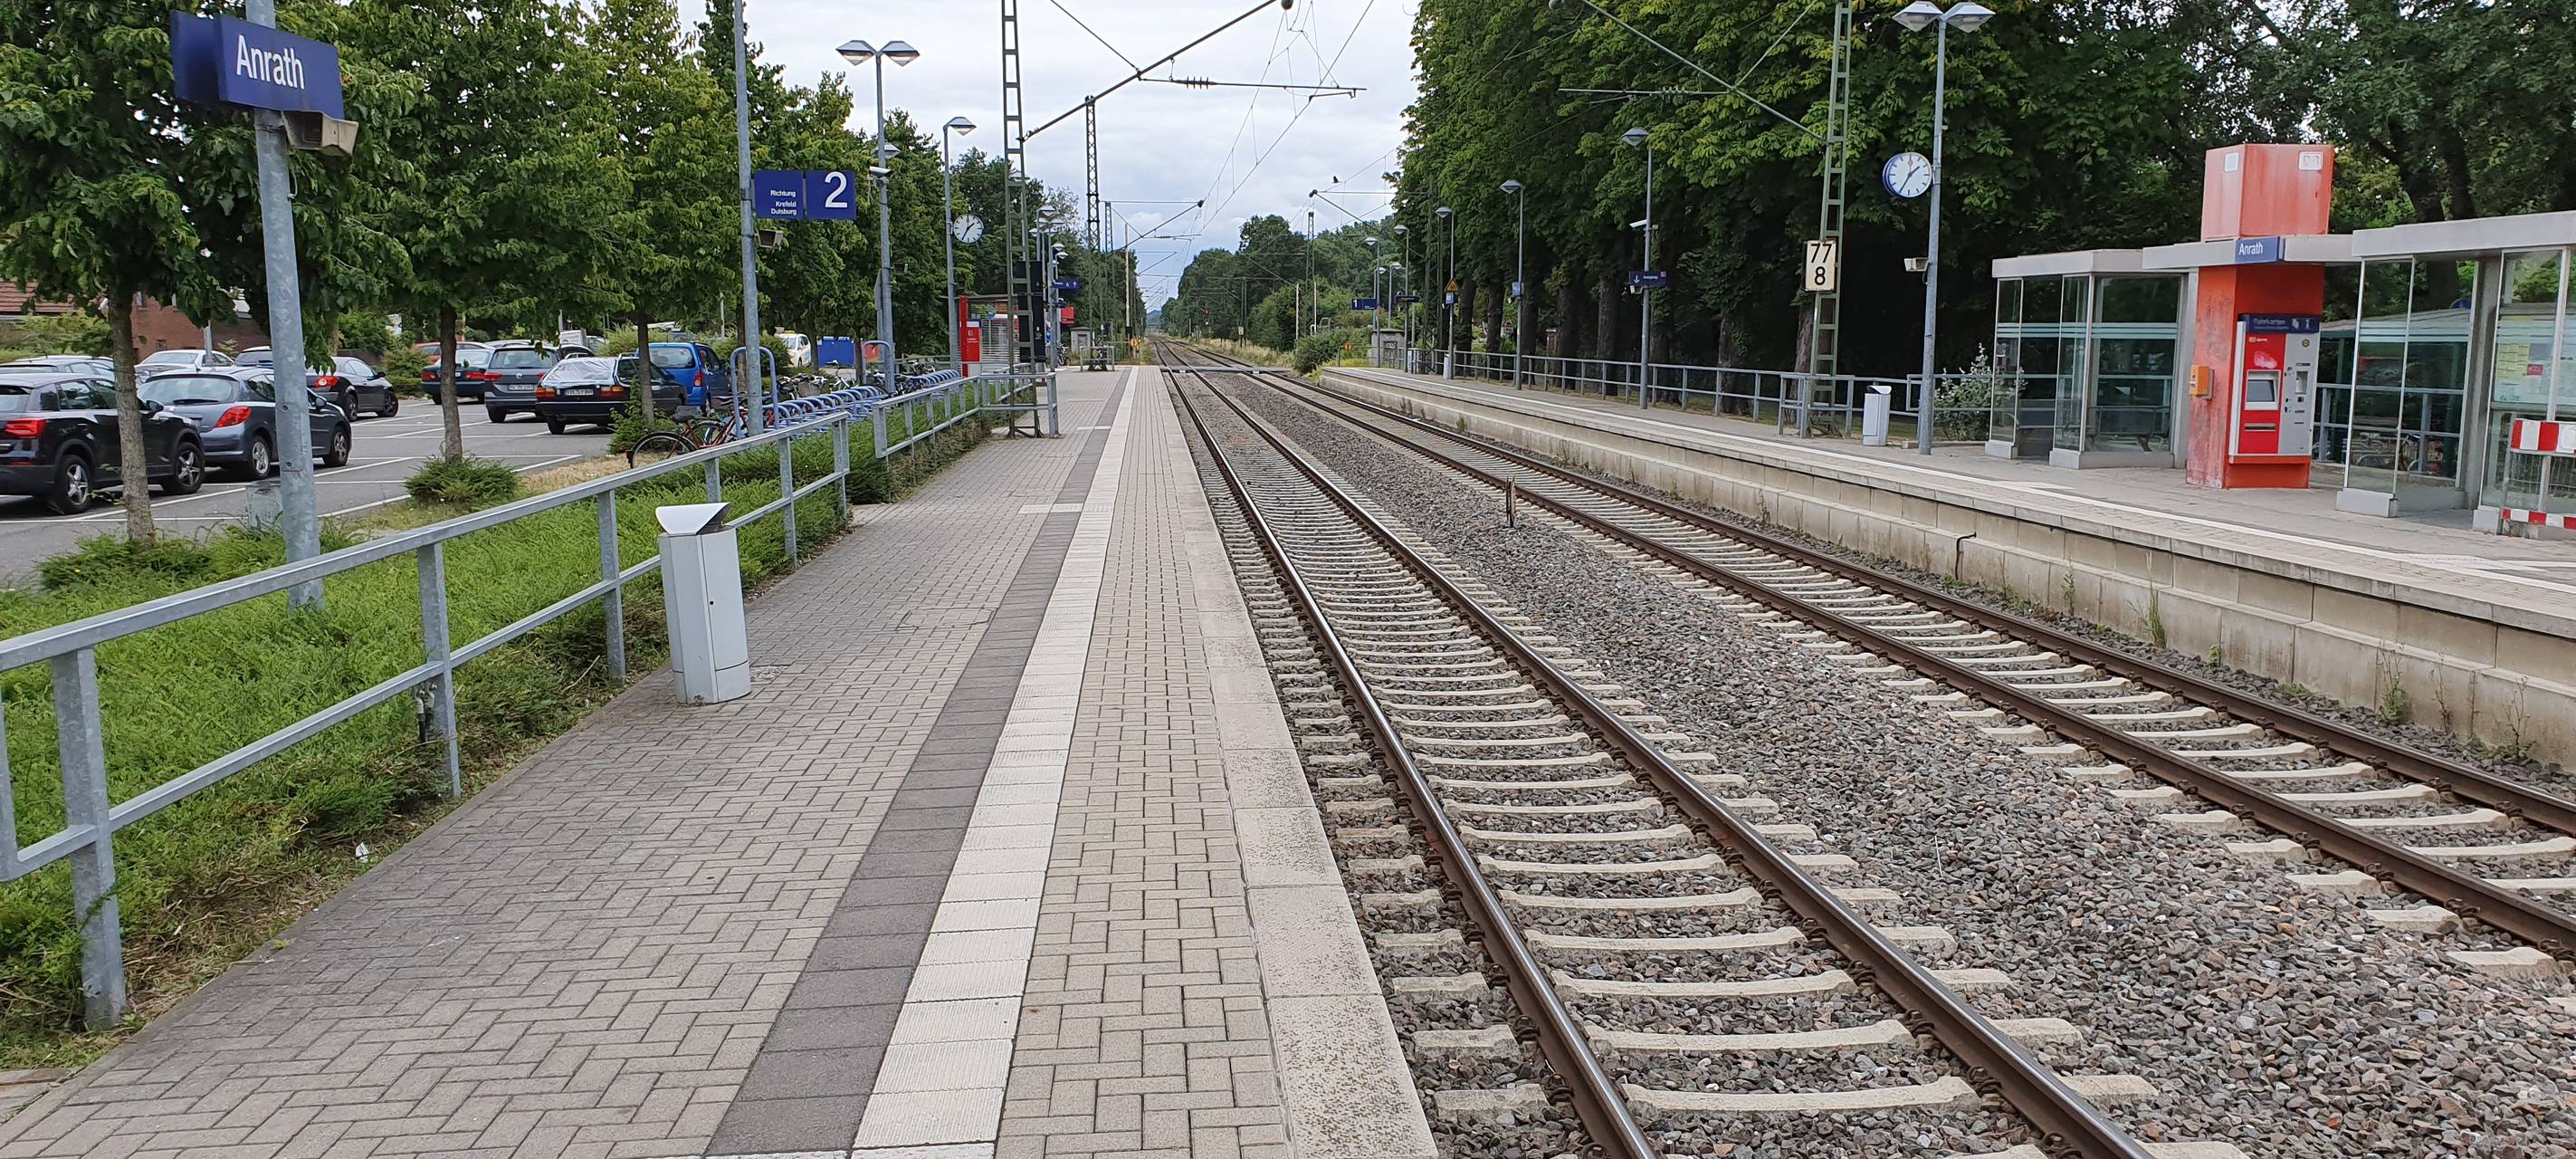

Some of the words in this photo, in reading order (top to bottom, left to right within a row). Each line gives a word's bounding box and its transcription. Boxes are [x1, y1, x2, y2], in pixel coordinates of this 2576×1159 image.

[236, 34, 305, 90] Anrath
[825, 171, 848, 208] 2
[1810, 244, 1832, 263] 77
[2238, 242, 2264, 255] Anrath
[1814, 266, 1827, 286] 8
[1353, 299, 1358, 308] 1
